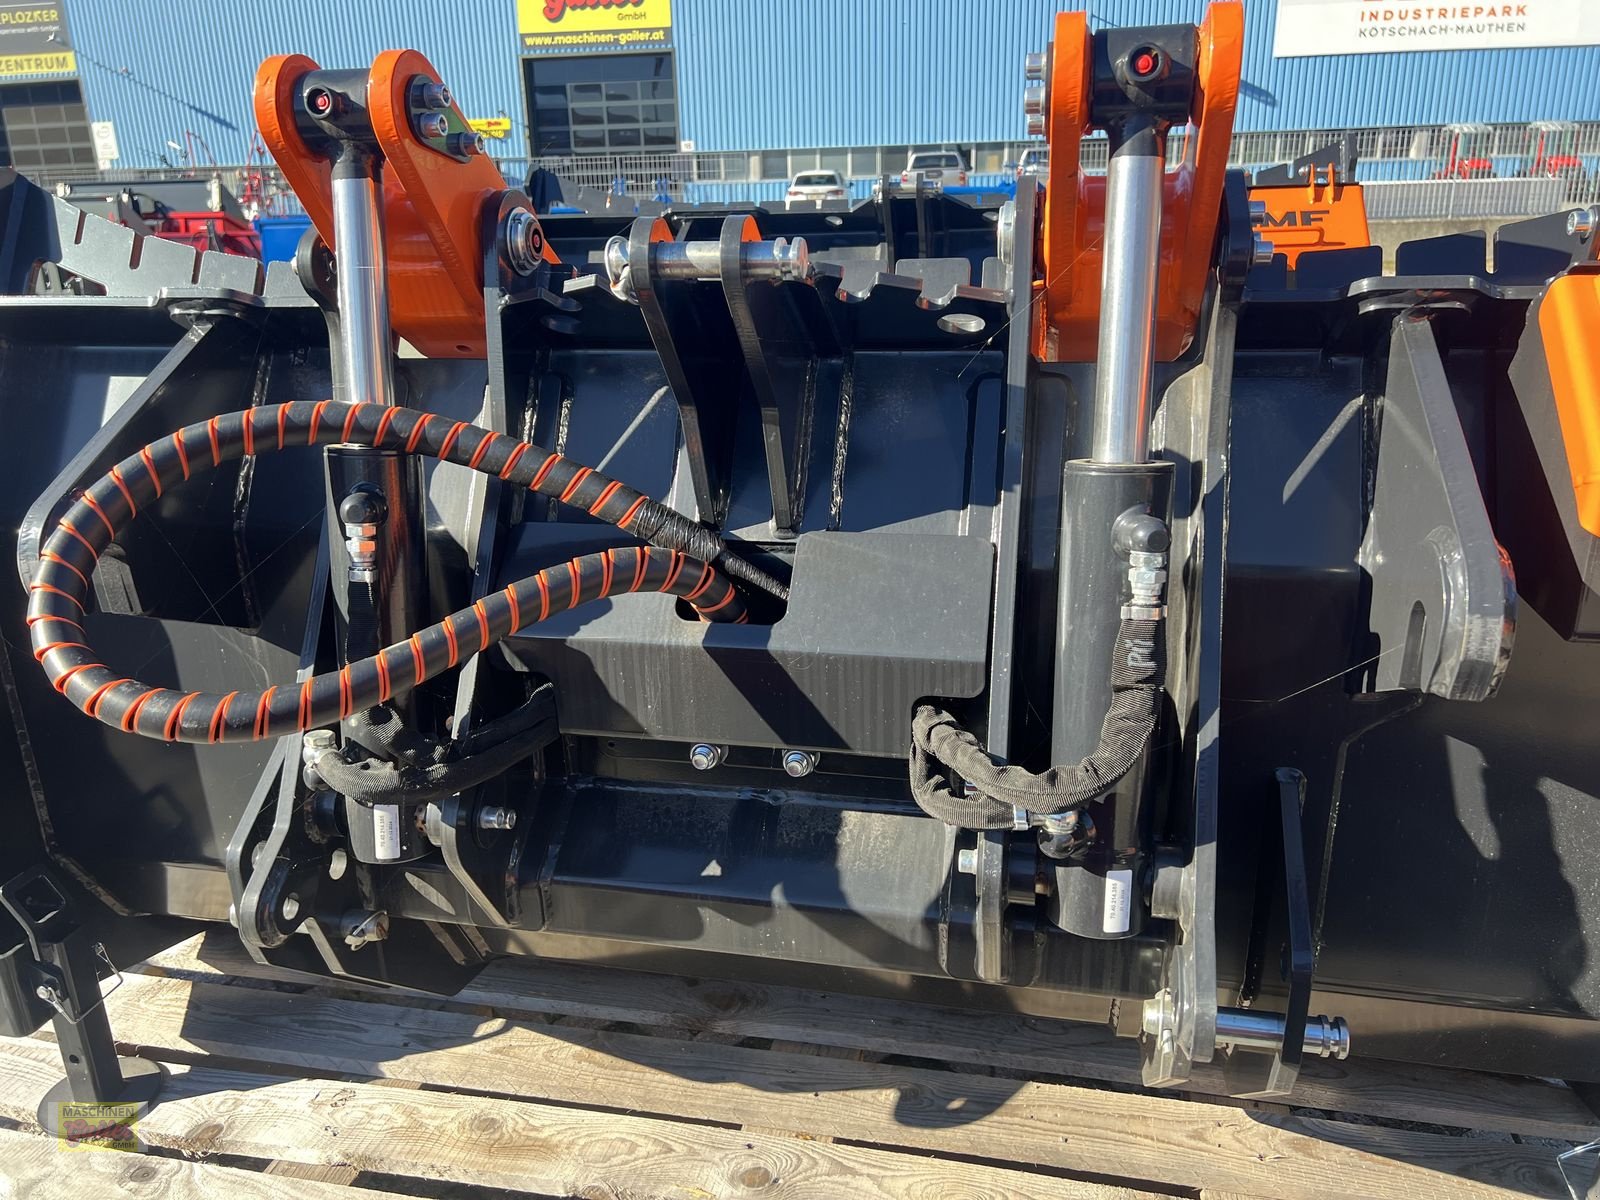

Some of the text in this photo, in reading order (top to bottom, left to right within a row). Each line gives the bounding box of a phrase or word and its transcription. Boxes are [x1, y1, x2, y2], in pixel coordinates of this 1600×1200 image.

[0, 9, 59, 25] PLOZKER
[617, 11, 648, 21] GmbH
[1361, 4, 1528, 22] INDUSTRIEPARK
[524, 29, 665, 46] www.maschinen-gailer.at
